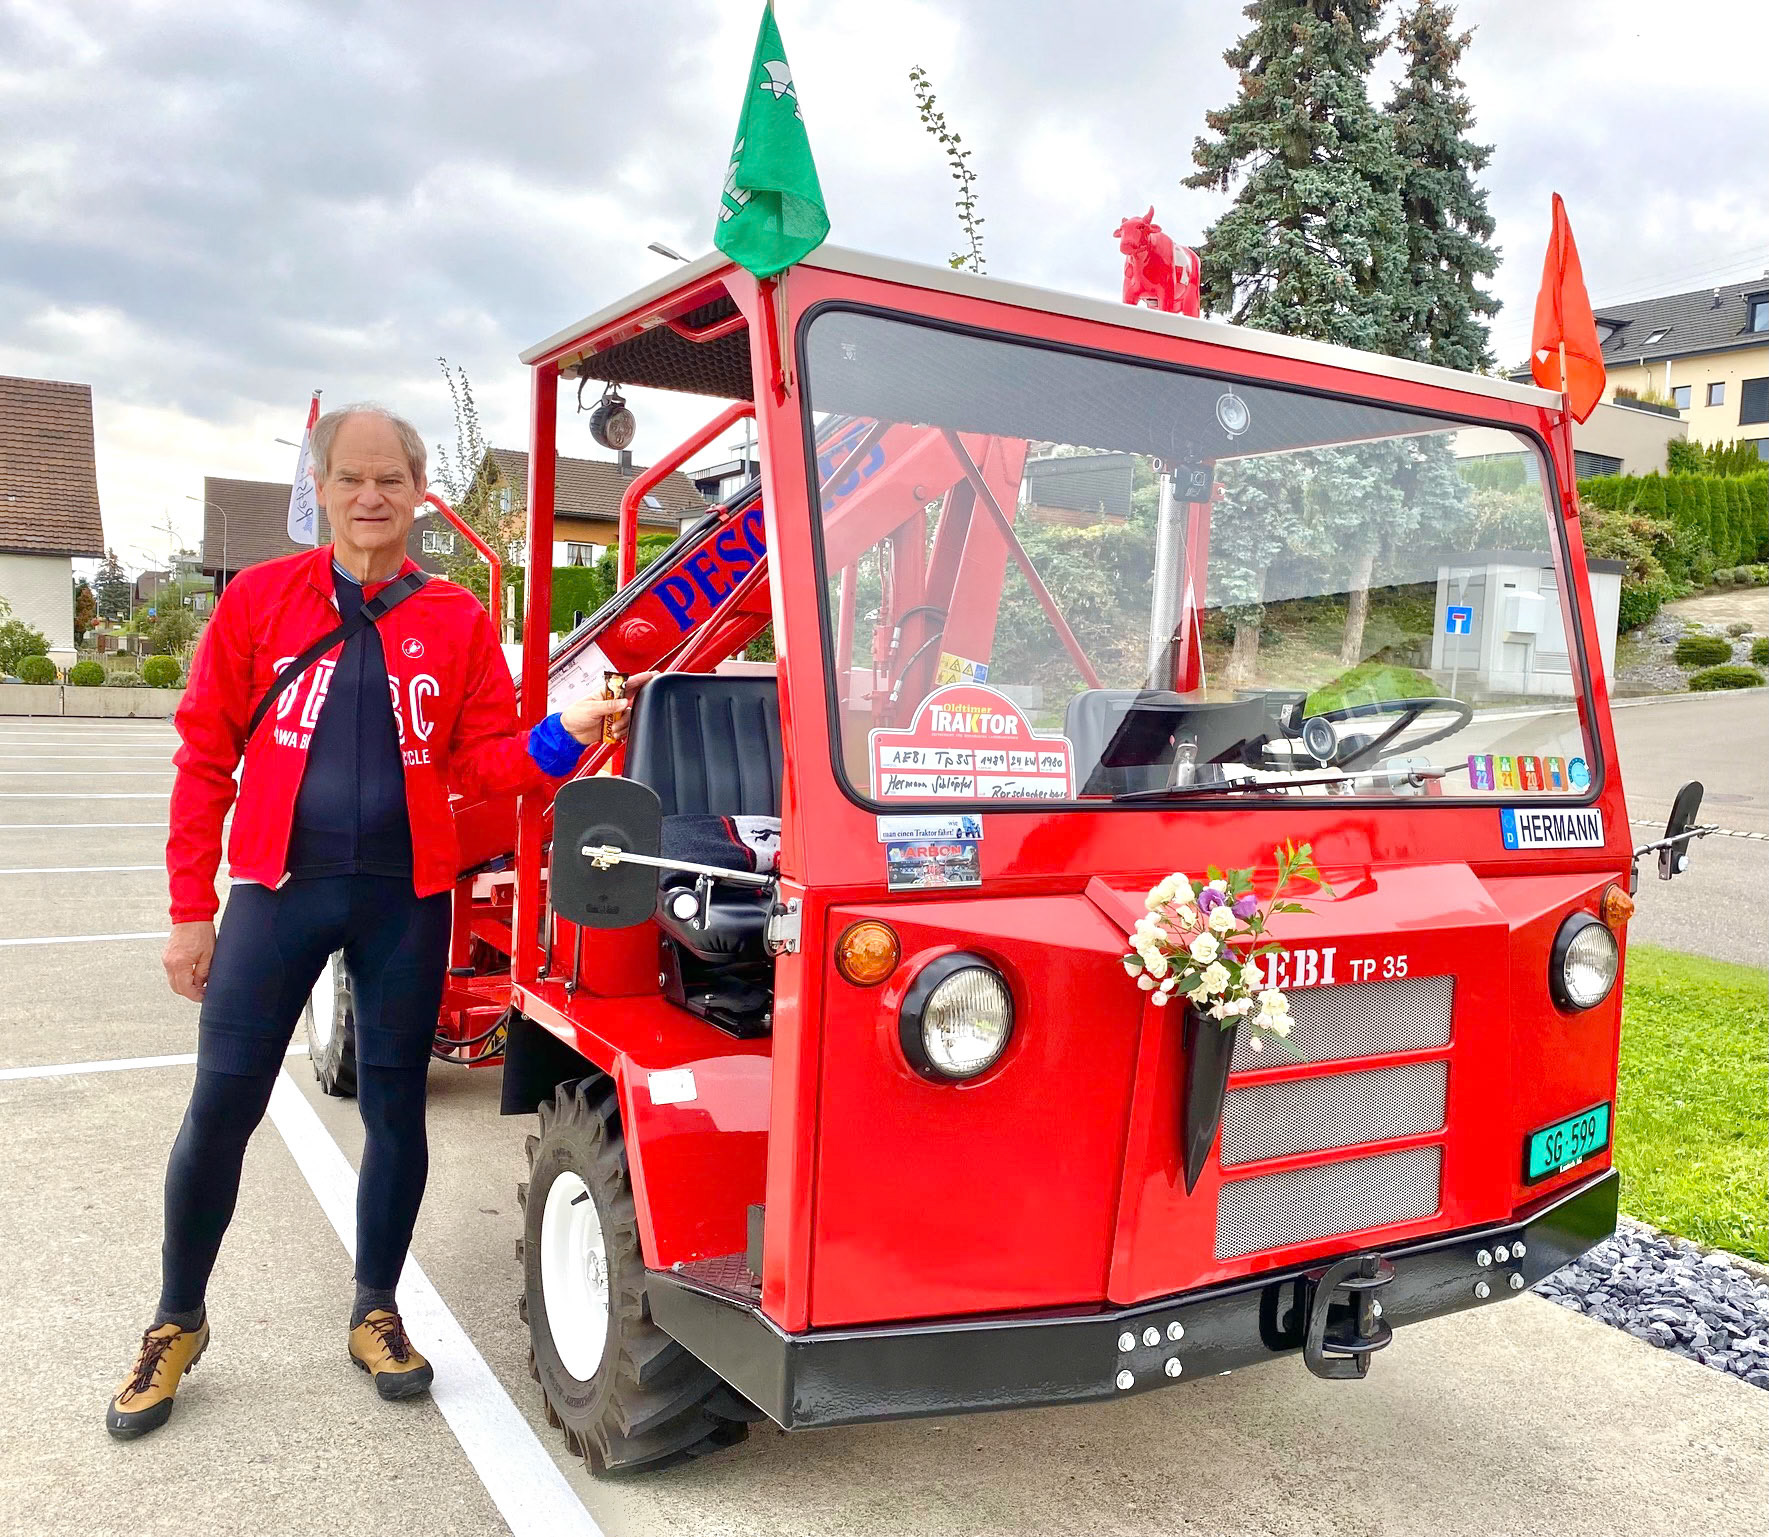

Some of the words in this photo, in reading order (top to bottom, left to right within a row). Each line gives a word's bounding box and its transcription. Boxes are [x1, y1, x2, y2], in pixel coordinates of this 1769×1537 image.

[943, 703, 992, 714] Oldtimer
[929, 704, 1019, 735] TRAKTOR
[893, 751, 926, 765] AEBI
[1010, 756, 1022, 766] 24
[1041, 756, 1063, 768] 1980
[884, 774, 927, 795] Hermann
[1476, 771, 1488, 785] 22
[1502, 772, 1513, 786] 21
[1526, 772, 1538, 786] 20
[914, 828, 937, 838] Traktor
[1520, 814, 1600, 842] HERMANN
[1508, 833, 1514, 843] D
[904, 845, 961, 858] ARBON
[1350, 959, 1376, 981] TP
[1383, 955, 1408, 978] 35
